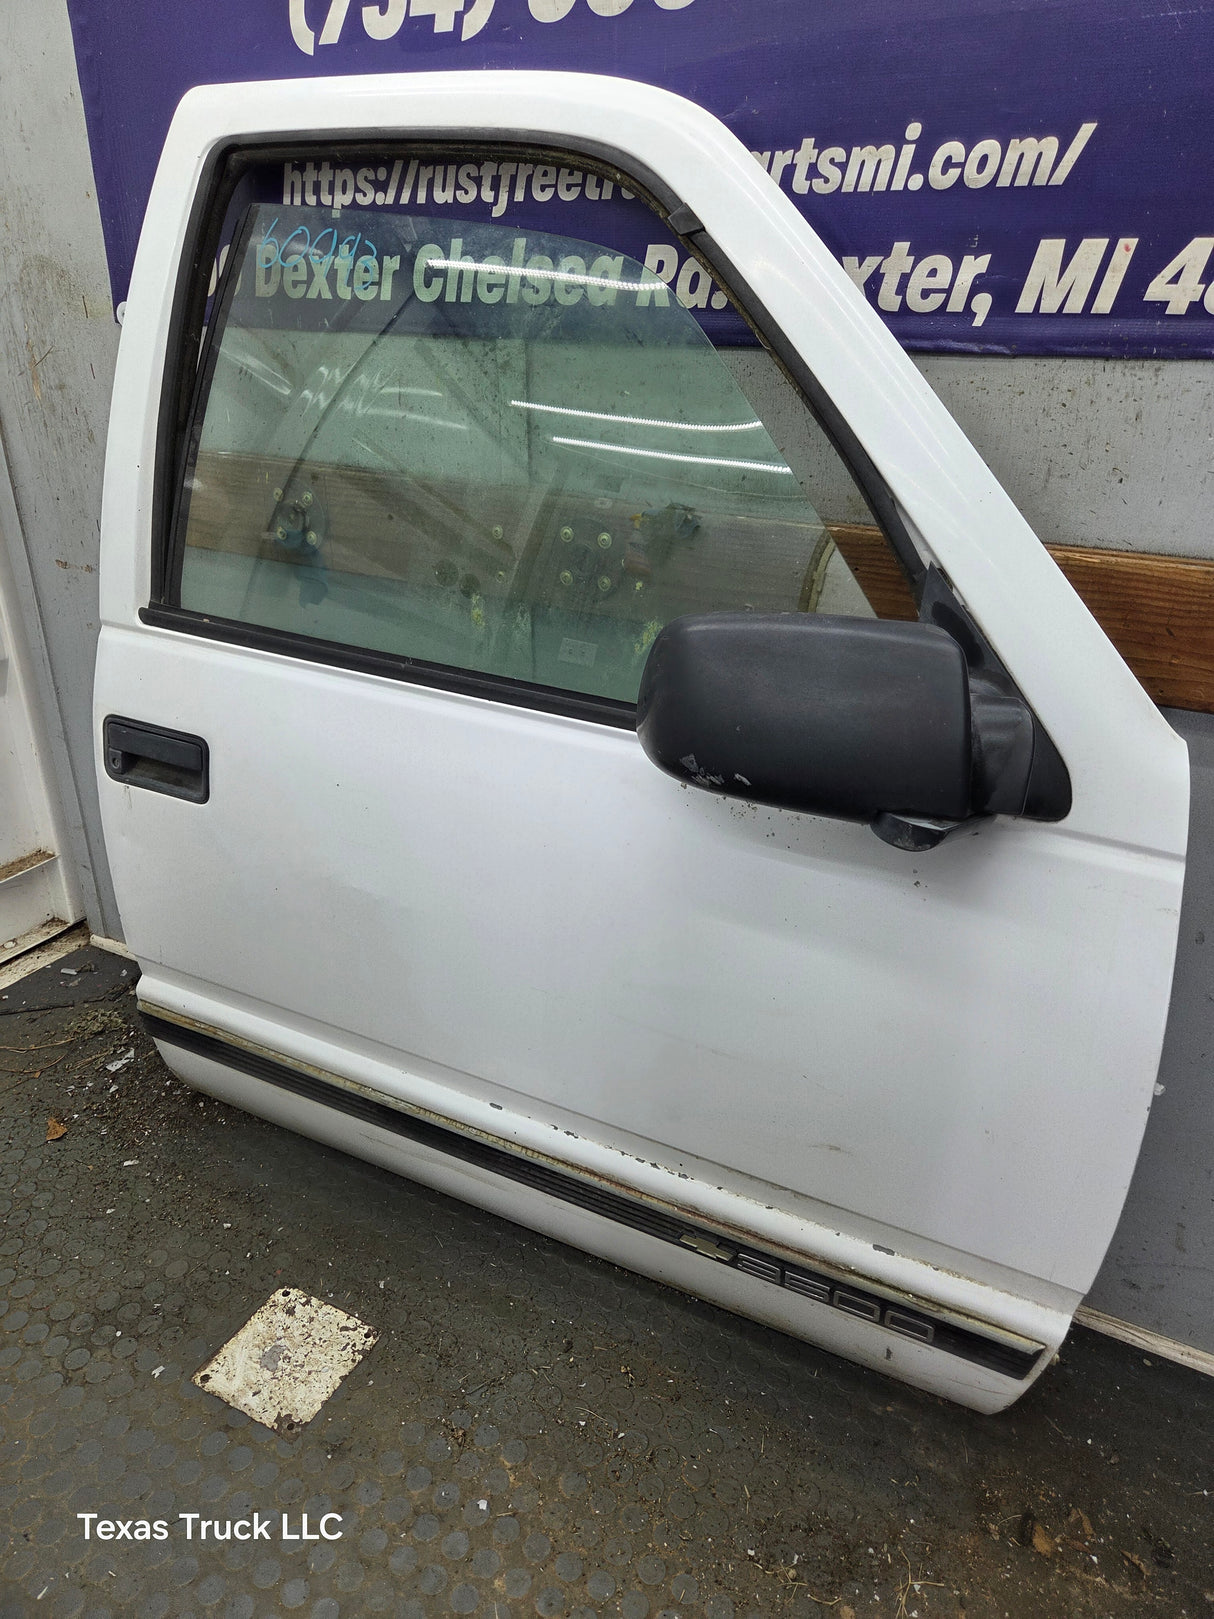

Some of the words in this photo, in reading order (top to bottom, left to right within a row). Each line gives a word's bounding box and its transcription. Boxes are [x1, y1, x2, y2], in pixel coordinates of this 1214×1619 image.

[255, 244, 402, 301] Dexter
[412, 238, 625, 307] Chelsea
[1014, 238, 1139, 314] MI
[1143, 237, 1214, 315] 4
[736, 1252, 935, 1343] 3500
